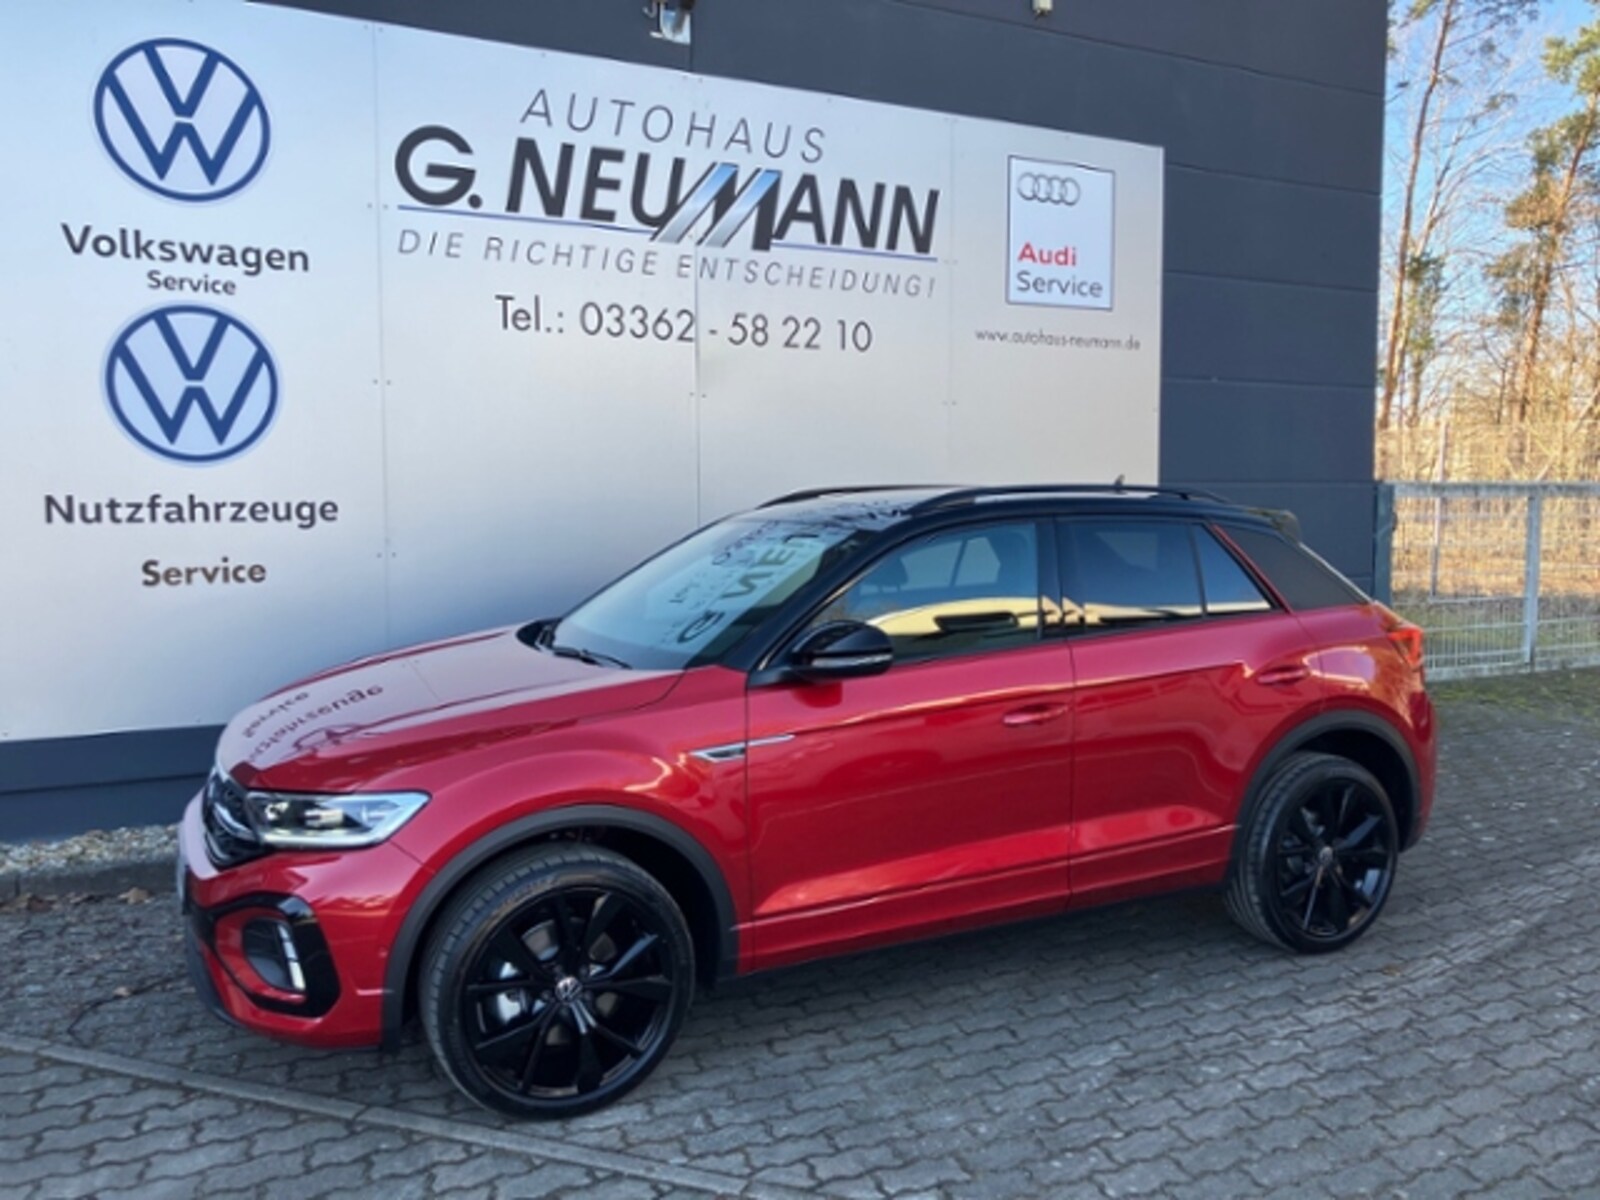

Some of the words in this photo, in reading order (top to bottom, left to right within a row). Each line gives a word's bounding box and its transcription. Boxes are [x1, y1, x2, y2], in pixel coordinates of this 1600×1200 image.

[519, 88, 826, 164] AUTOHAUS
[394, 125, 483, 209] G.
[504, 136, 940, 254] NEUMANN
[60, 222, 310, 277] Volkswagen
[397, 229, 464, 259] DIE
[483, 236, 659, 277] RICHTIGE
[676, 254, 936, 298] ENTSCHEIDUNG!
[1017, 241, 1077, 267] Audi
[146, 269, 237, 296] Service
[1016, 270, 1104, 299] Service
[495, 294, 564, 333] Tel.:
[579, 301, 695, 343] 03362
[728, 312, 769, 347] 58
[782, 315, 821, 350] 22
[838, 319, 873, 353] 10
[975, 328, 1142, 351] www.autohaus-neumann.de
[44, 494, 339, 530] Nutzfahrzeuge
[141, 556, 267, 587] Service
